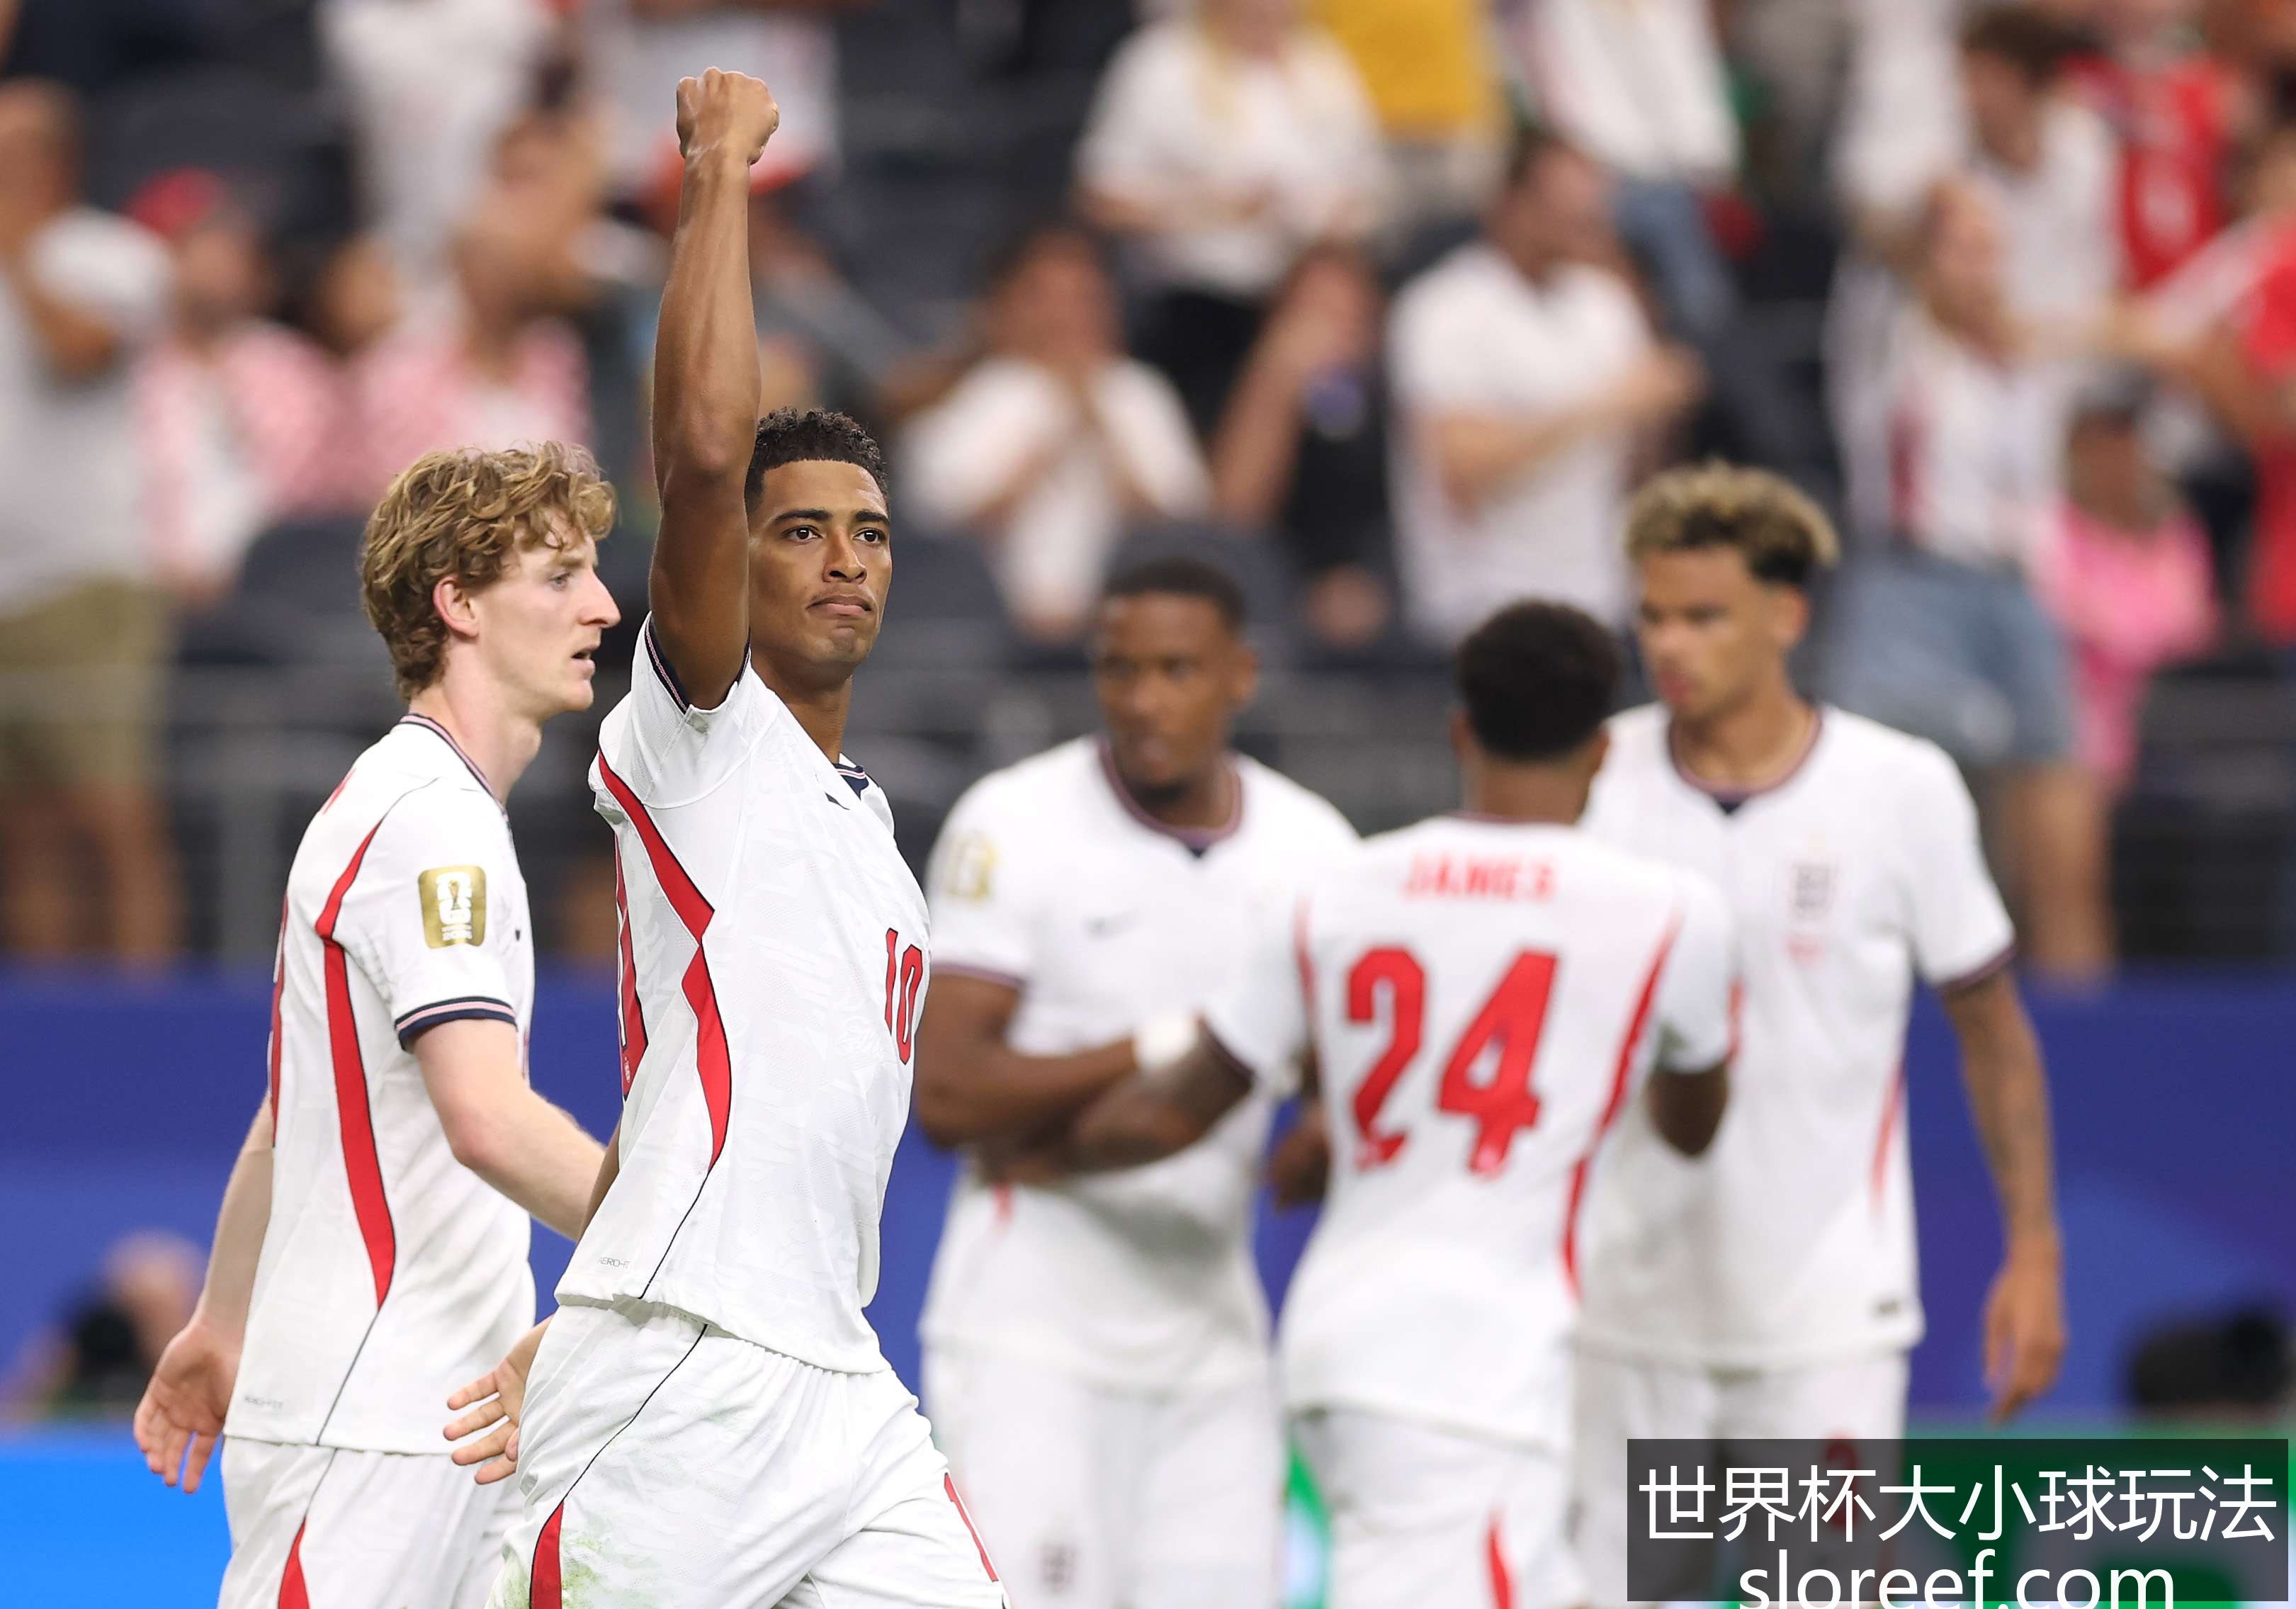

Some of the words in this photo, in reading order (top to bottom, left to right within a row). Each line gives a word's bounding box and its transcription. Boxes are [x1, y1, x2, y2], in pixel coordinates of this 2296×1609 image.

[1404, 852, 1556, 901] JAMES
[885, 927, 923, 1066] 10
[1345, 942, 1561, 1178] 24
